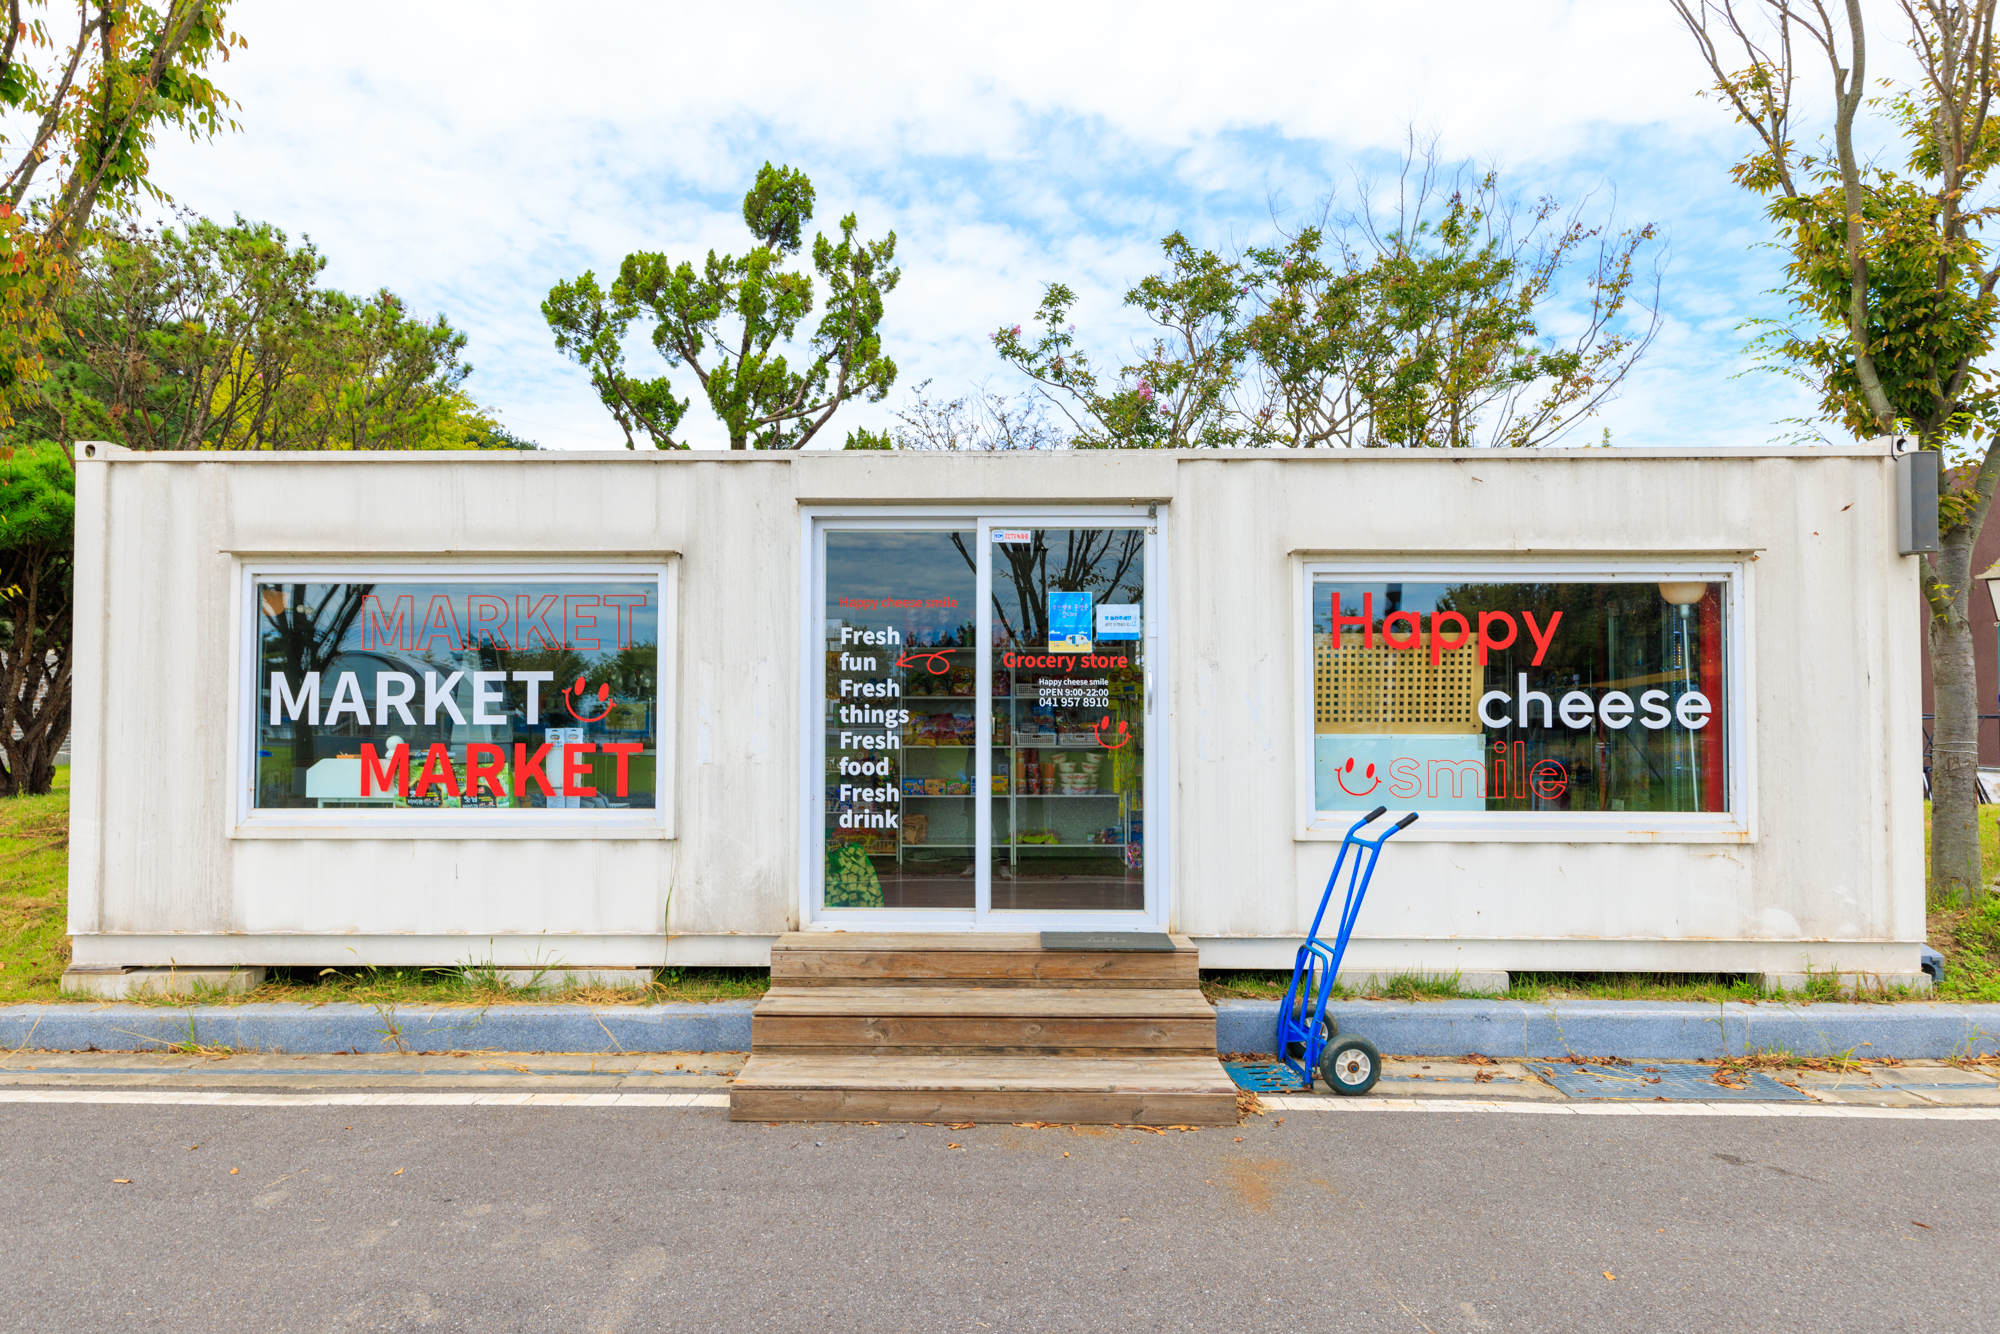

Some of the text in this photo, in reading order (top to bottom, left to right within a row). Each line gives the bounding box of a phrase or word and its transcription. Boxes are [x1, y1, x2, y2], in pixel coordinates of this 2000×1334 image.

[839, 596, 958, 611] Happy cheese smile
[361, 594, 646, 651] MARKET
[1332, 592, 1563, 666] Happy
[842, 626, 900, 644] Fresh
[840, 652, 876, 671] fun
[1003, 652, 1128, 672] Grocery store
[841, 678, 900, 697] Fresh
[1039, 678, 1109, 687] Happy cheese smile
[271, 671, 553, 726] MARKET
[1039, 688, 1109, 697] OPEN 9:00-22:00
[1039, 697, 1109, 707] 041 957 8910
[1478, 672, 1711, 729] cheese
[839, 704, 909, 727] things
[841, 730, 900, 749] Fresh
[360, 743, 643, 798] MARKET
[839, 757, 889, 775] food
[1389, 741, 1567, 800] smile
[840, 783, 899, 802] Fresh
[839, 809, 898, 828] drink
